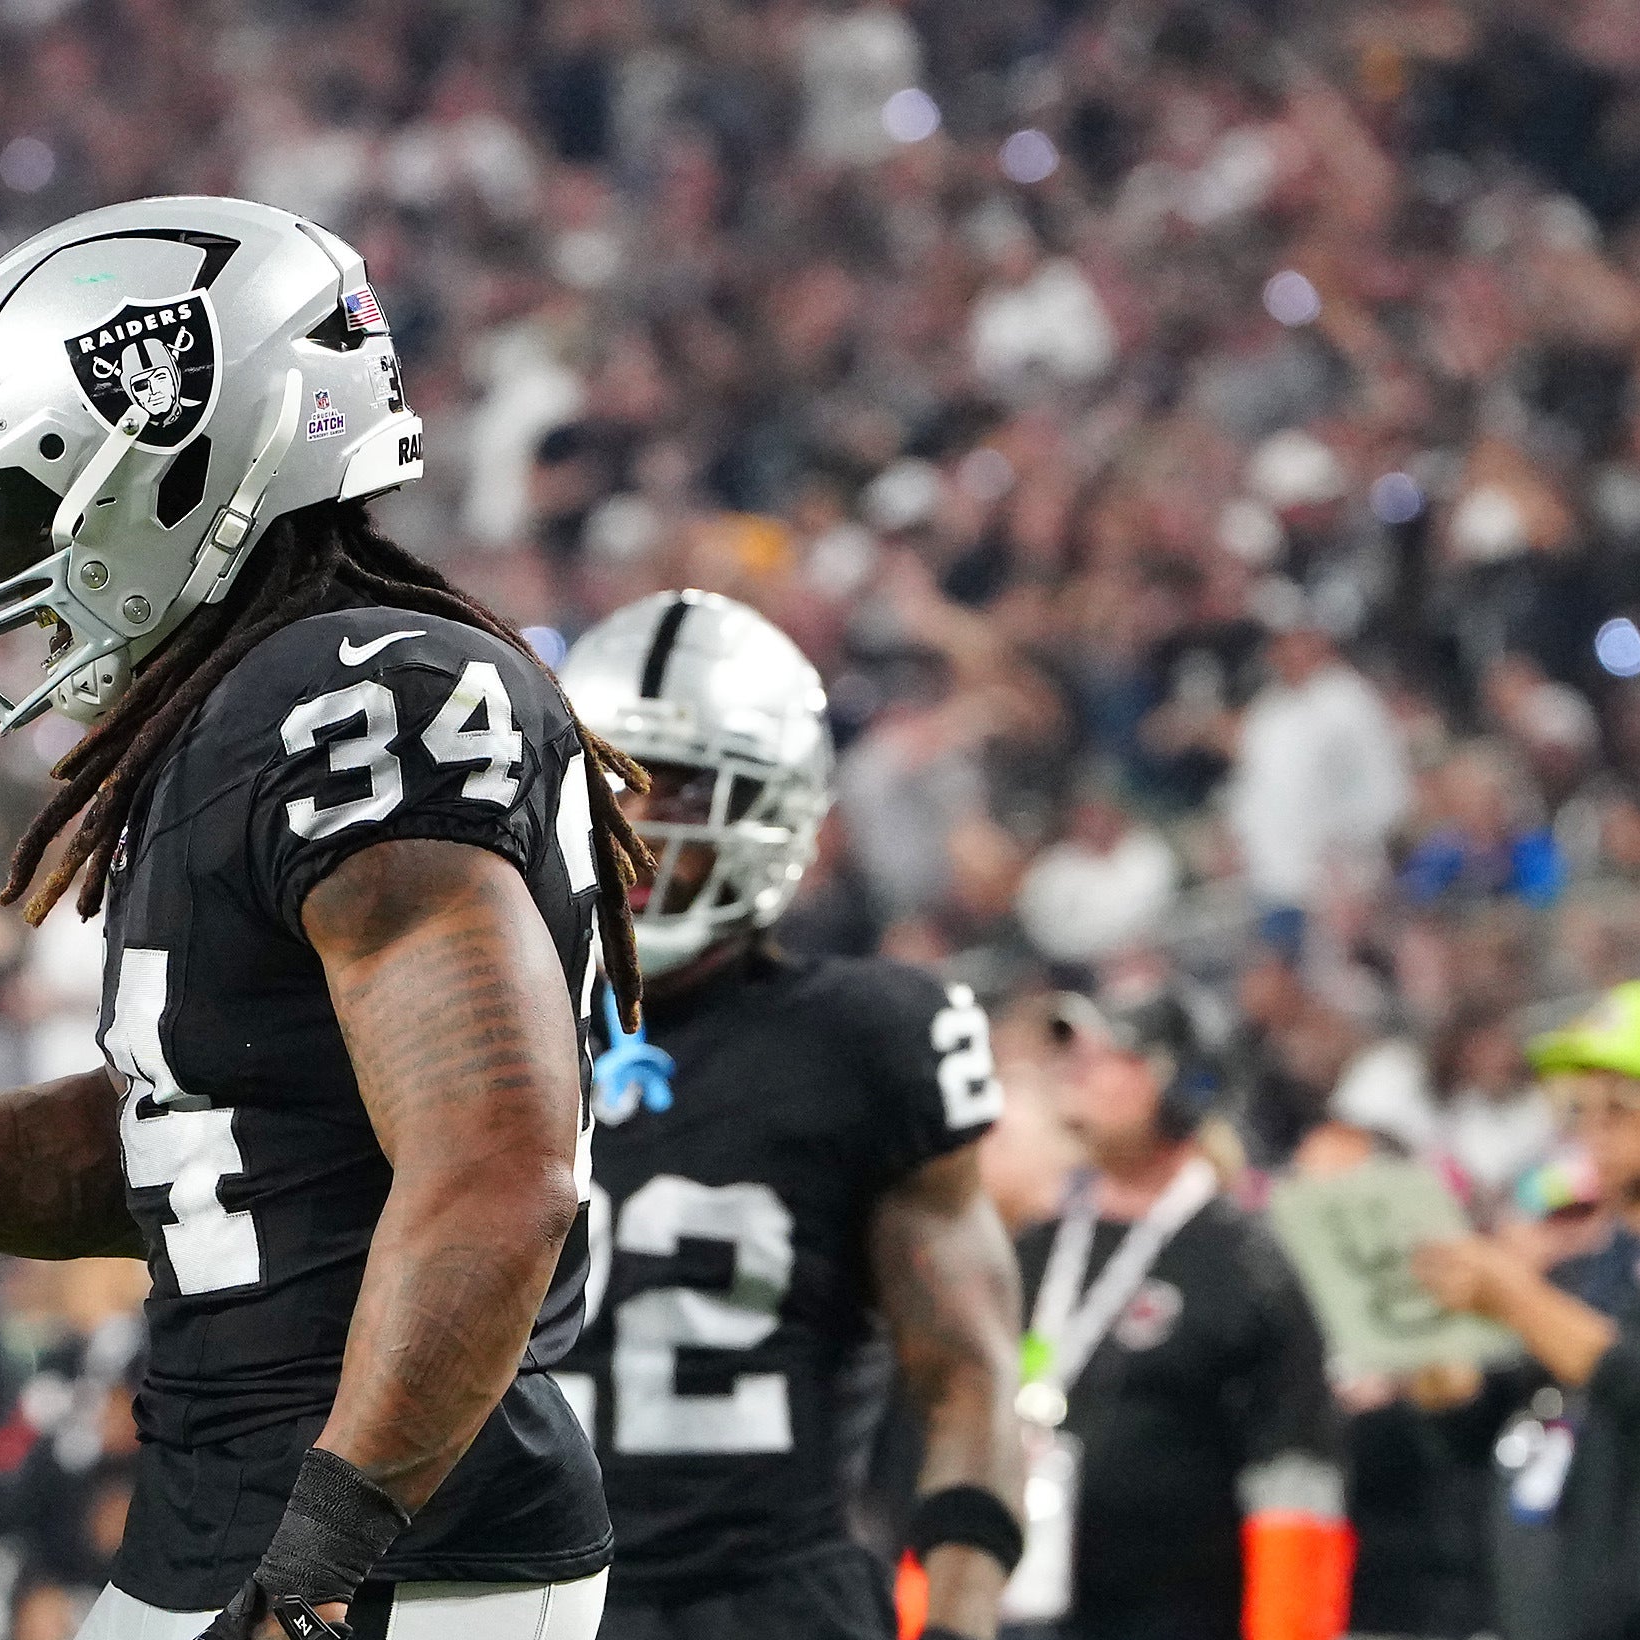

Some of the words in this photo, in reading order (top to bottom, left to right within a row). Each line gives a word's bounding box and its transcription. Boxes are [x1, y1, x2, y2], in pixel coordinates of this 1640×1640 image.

[78, 303, 192, 354] RAIDERS
[309, 415, 344, 434] CATCH
[312, 410, 338, 420] CRUCIAL
[280, 660, 523, 842] 34
